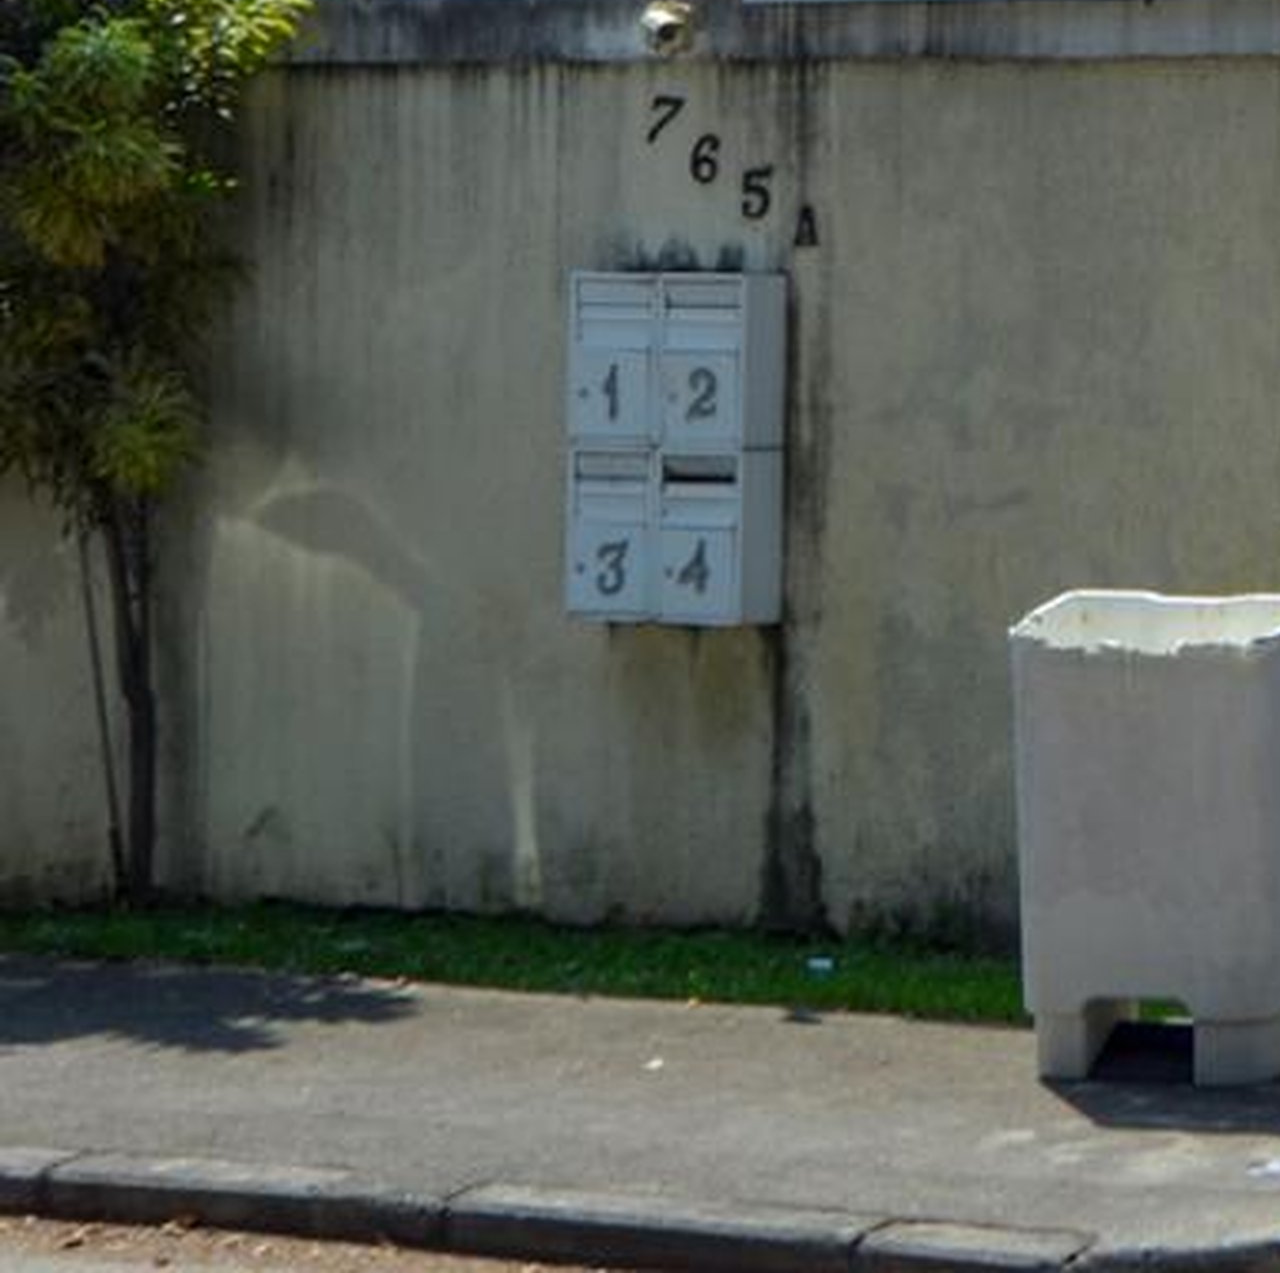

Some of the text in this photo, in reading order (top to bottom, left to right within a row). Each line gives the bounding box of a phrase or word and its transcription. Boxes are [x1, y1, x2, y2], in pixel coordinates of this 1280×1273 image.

[603, 363, 620, 421] 1
[685, 366, 718, 421] 2
[595, 538, 630, 596] 3
[676, 537, 710, 595] 4
